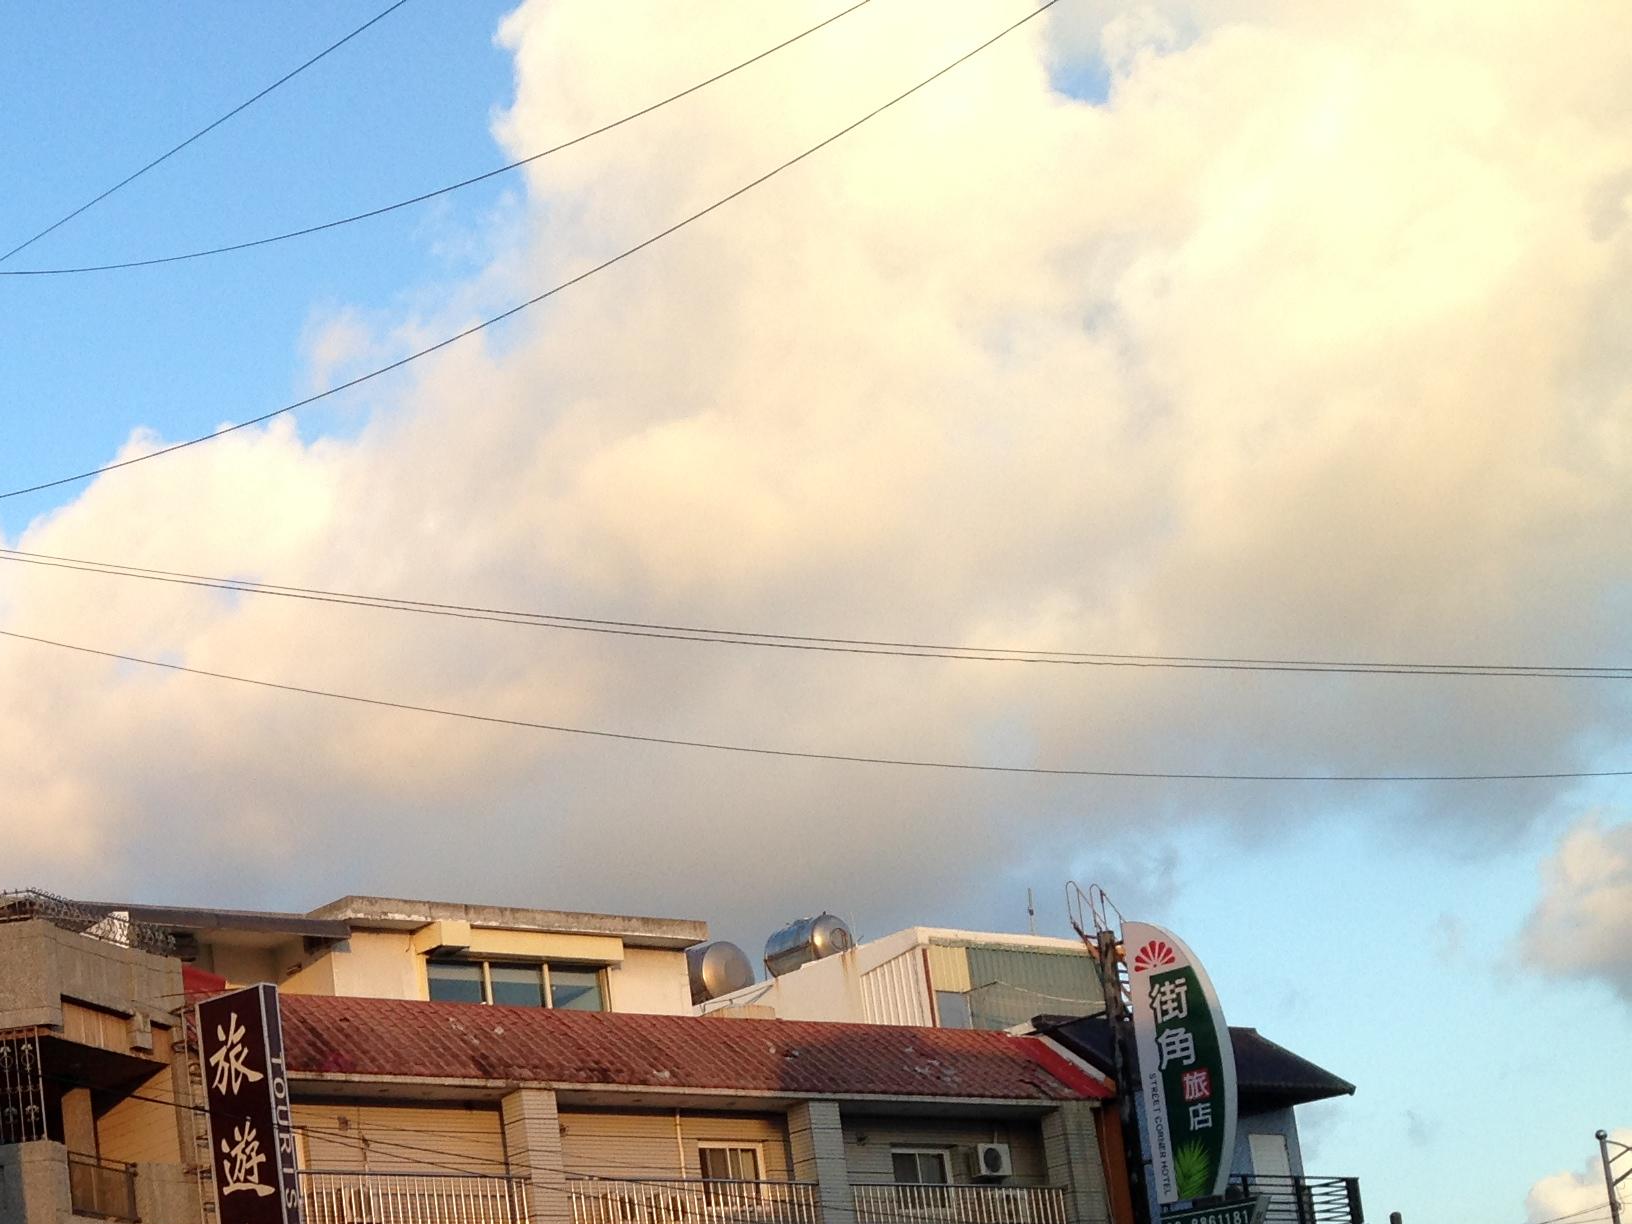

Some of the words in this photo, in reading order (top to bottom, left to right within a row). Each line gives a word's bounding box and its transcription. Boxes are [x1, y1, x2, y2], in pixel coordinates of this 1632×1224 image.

[1148, 976, 1213, 1130] 街角旅店
[1149, 1072, 1161, 1112] STREET
[1154, 1116, 1167, 1158] CORNER
[1161, 1160, 1171, 1194] HOTEL
